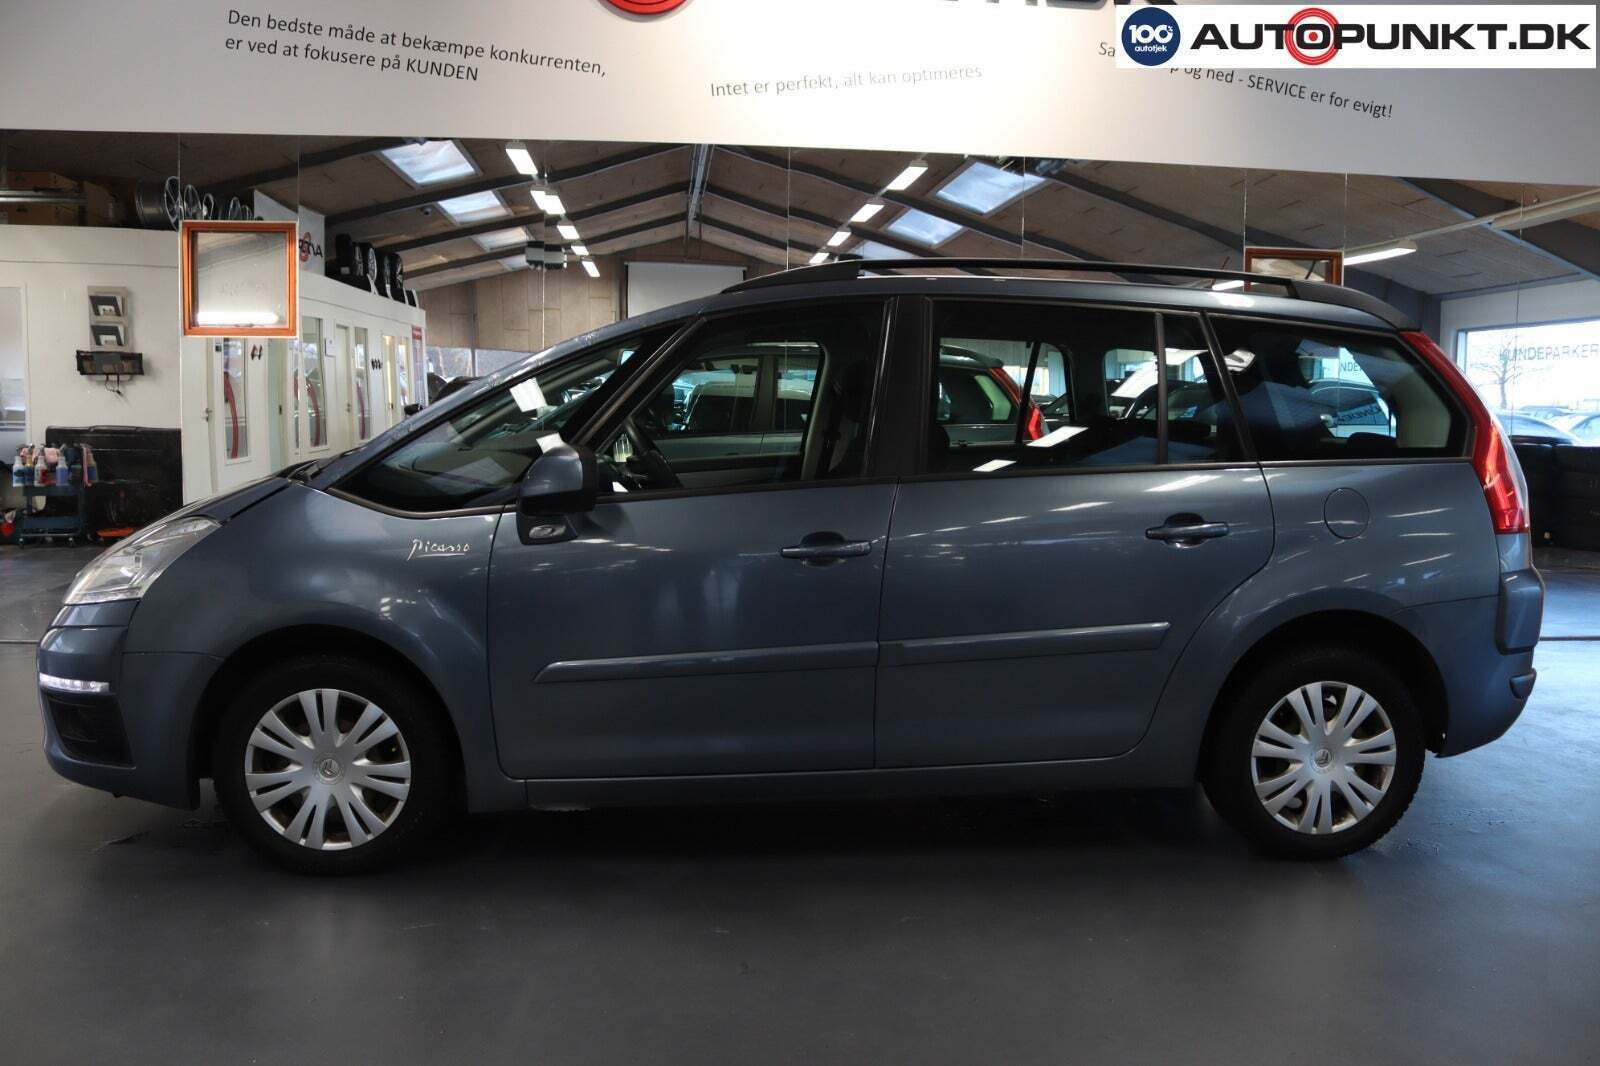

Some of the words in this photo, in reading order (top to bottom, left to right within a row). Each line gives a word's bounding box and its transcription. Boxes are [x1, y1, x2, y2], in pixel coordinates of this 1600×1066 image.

[225, 37, 244, 51] er
[247, 39, 278, 55] ved
[282, 43, 300, 58] at
[303, 42, 376, 67] fokusere
[380, 53, 401, 73] på
[406, 57, 479, 82] KUNDEN
[228, 9, 261, 29] Den
[266, 13, 324, 37] bedste
[328, 23, 376, 44] måde
[379, 31, 398, 47] at
[401, 31, 485, 60] bekæmpe
[489, 43, 606, 78] konkurrenten,
[710, 81, 750, 98] Intet
[753, 80, 771, 95] er
[775, 73, 840, 97] perfekt,
[843, 71, 864, 88] alt
[868, 71, 898, 86] kan
[901, 64, 983, 87] optimeres
[1206, 68, 1236, 84] ned
[1246, 73, 1308, 100] SERVICE
[1310, 90, 1327, 104] er
[1329, 90, 1351, 109] for
[1352, 99, 1393, 120] evigt!
[407, 538, 470, 561] Picasso
